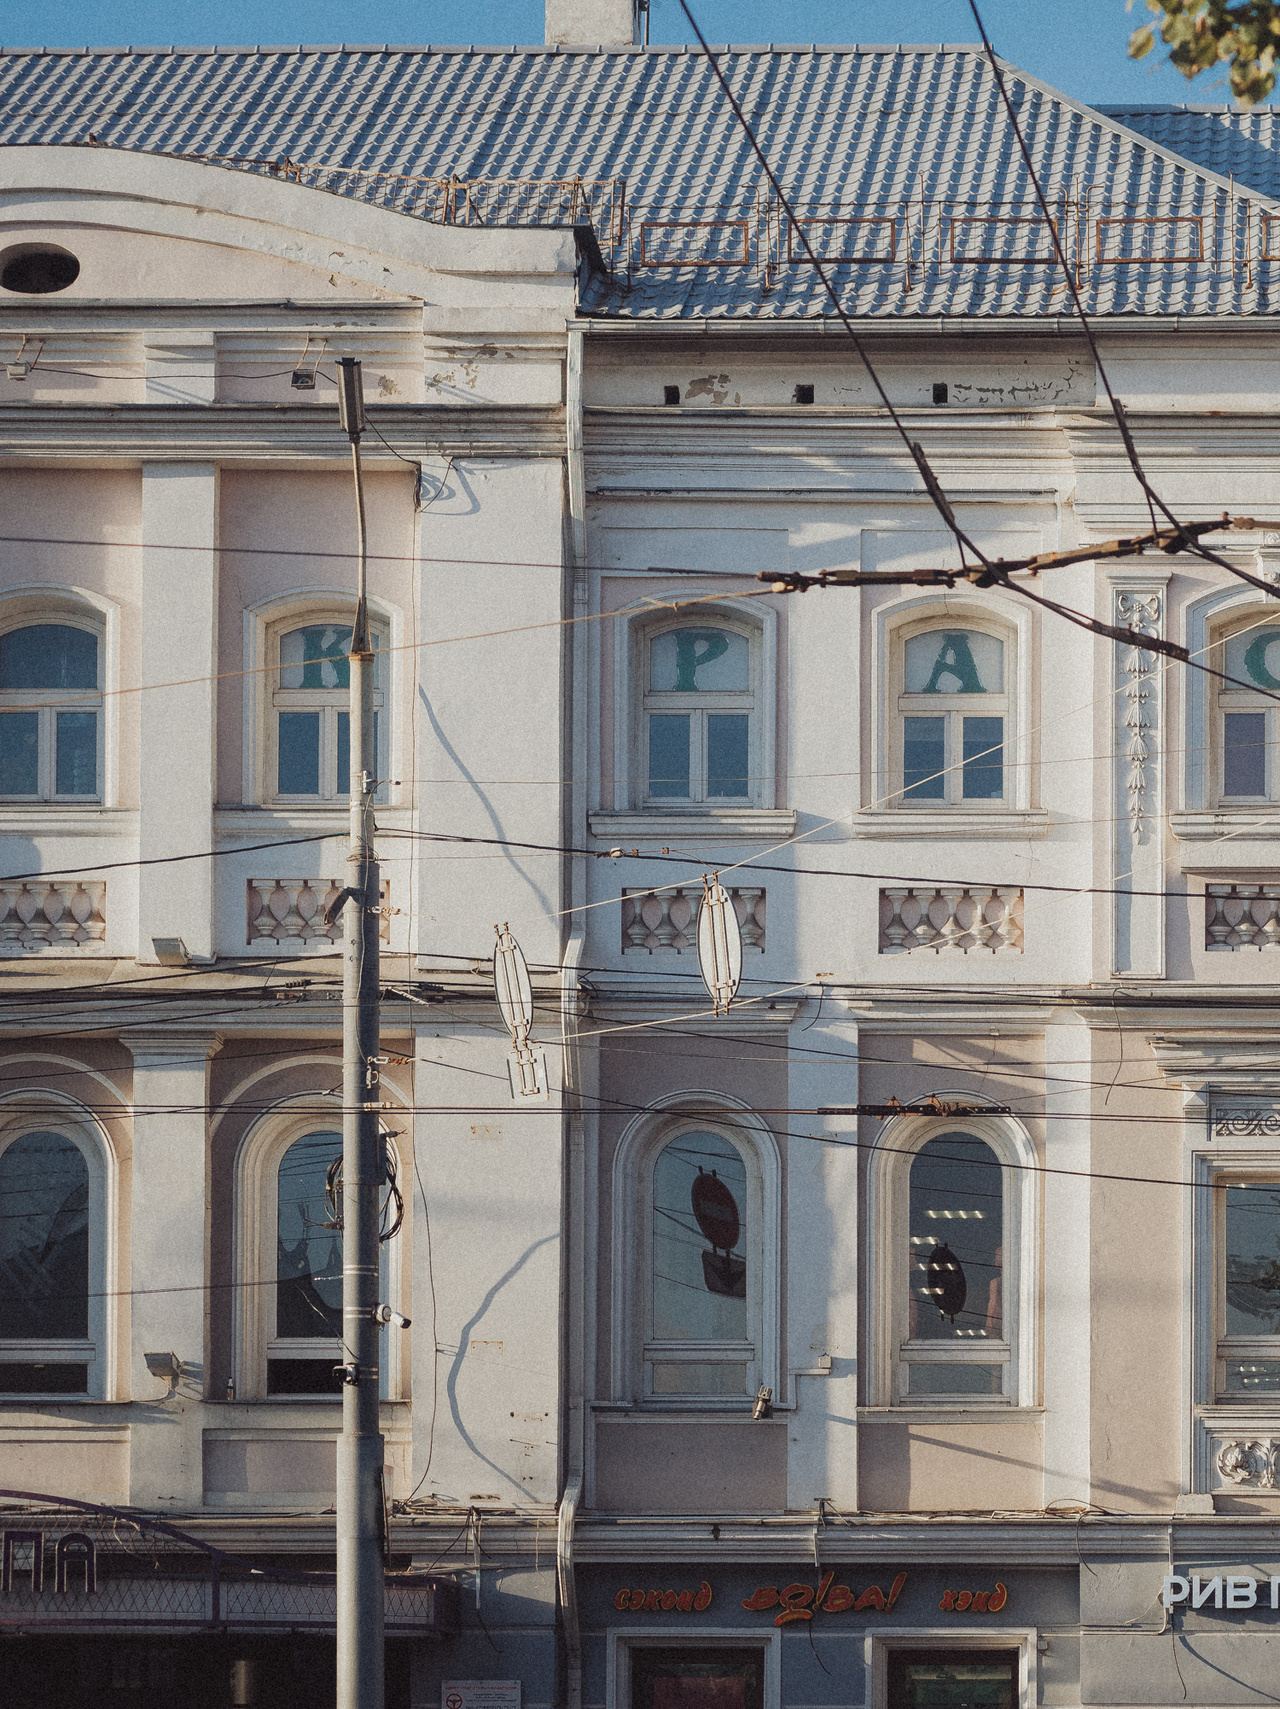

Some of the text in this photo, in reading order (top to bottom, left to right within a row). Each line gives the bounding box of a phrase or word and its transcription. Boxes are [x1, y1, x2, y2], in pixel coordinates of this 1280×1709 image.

[614, 1580, 712, 1611] сэконд
[938, 1582, 1008, 1612] хэнд
[1163, 1575, 1257, 1609] РИВ
